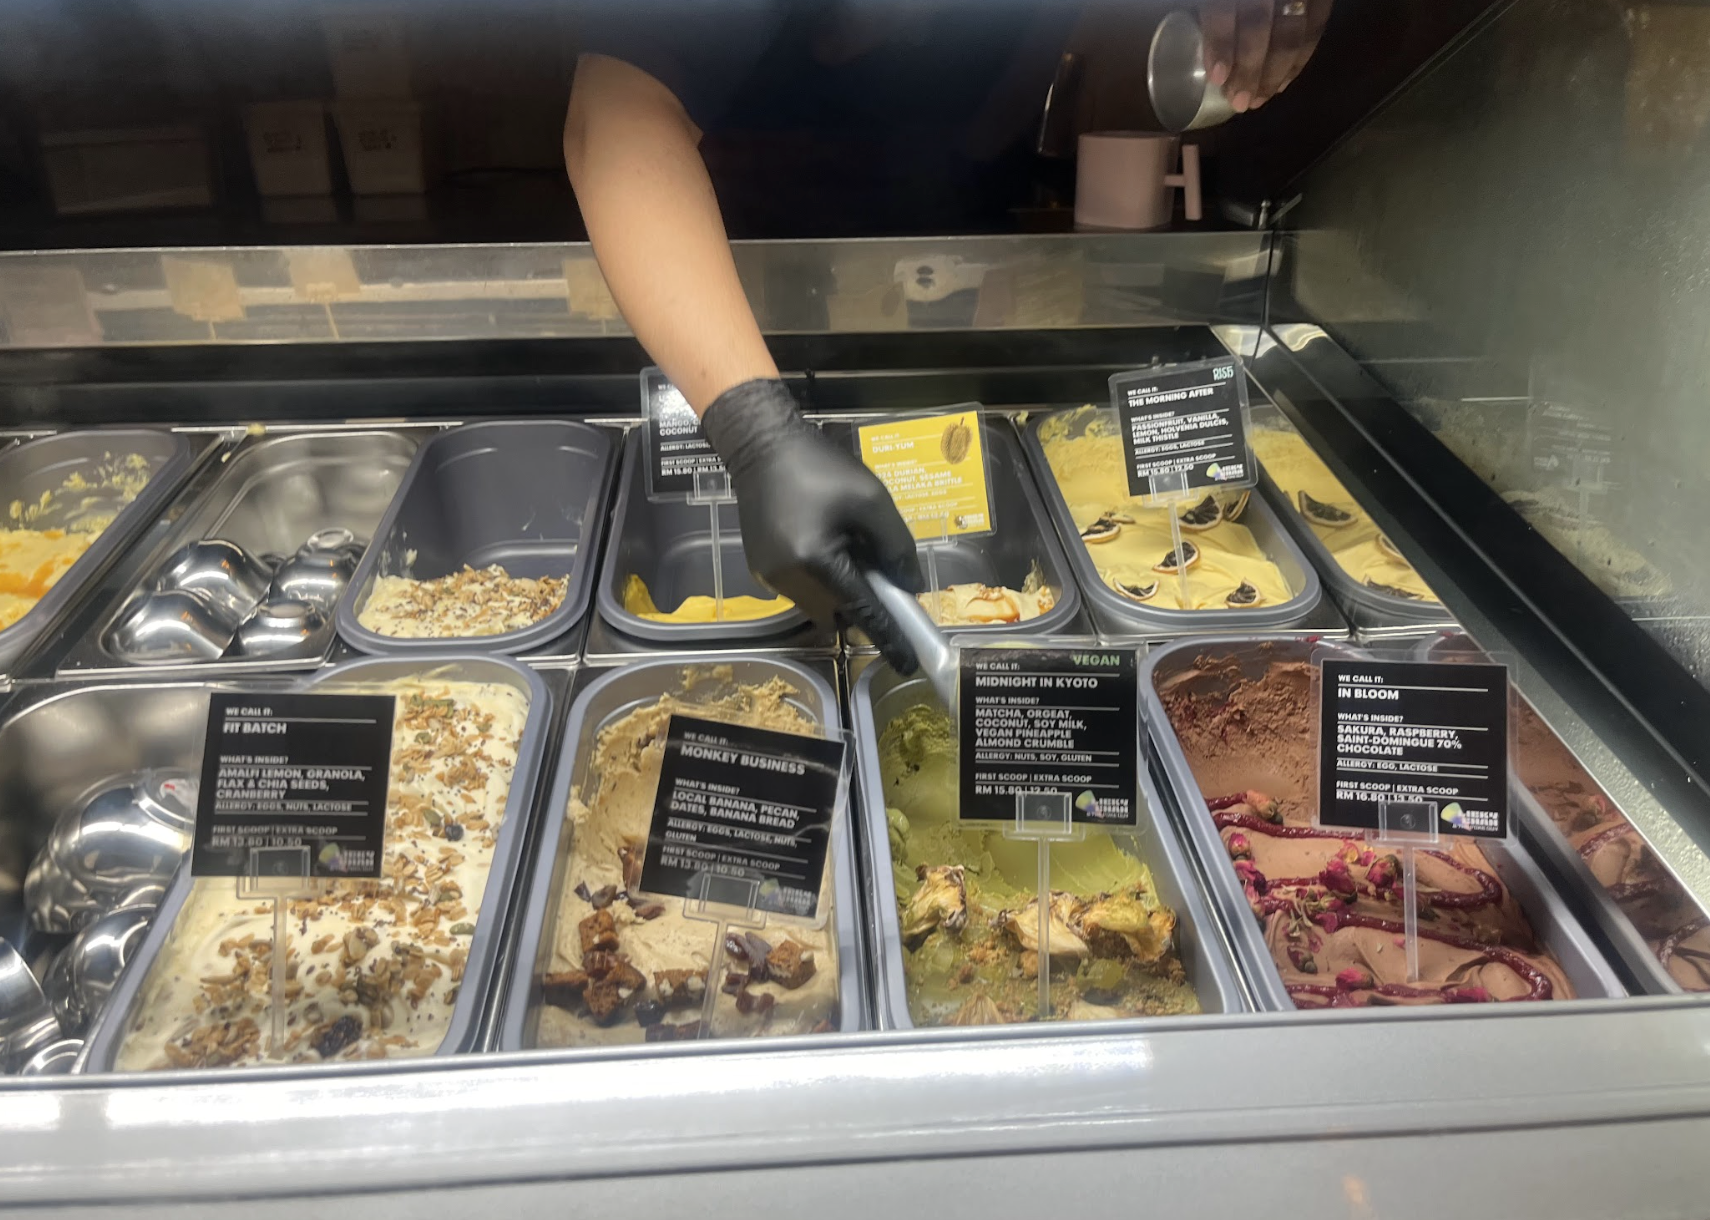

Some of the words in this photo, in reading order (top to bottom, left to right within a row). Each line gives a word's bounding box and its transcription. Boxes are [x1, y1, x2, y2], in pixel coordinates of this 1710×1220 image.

[1129, 398, 1144, 407] THE
[1146, 392, 1187, 405] MORNING
[1189, 388, 1213, 398] AFTER
[660, 426, 698, 436] COCONUT
[1133, 429, 1159, 438] LEMON,
[1152, 433, 1179, 442] THISTLE
[1154, 459, 1172, 468] SCOOP
[1196, 453, 1216, 461] SCOOP
[919, 471, 951, 480] SESAME
[901, 481, 931, 491] MELAKA
[935, 477, 962, 486] BRITTLE
[1073, 655, 1120, 666] VEGAN
[976, 677, 1036, 687] MIDNIGHT
[1040, 678, 1052, 687] IN
[1056, 678, 1098, 688] KYOTO
[1338, 688, 1351, 698] IN
[1354, 689, 1399, 700] BLOOM
[226, 707, 239, 716] WE
[241, 708, 261, 716] CALL
[976, 709, 1024, 719] MATCHA,
[1027, 710, 1072, 720] ORGEAT,
[1338, 713, 1369, 721] WHAT'S
[1371, 714, 1403, 722] INSIDE?
[224, 722, 240, 733] FIT
[243, 723, 287, 734] BATCH
[976, 719, 1031, 729] COCONUT,
[1034, 720, 1055, 728] SOY
[1059, 720, 1087, 730] MILK,
[684, 731, 696, 740] WE
[698, 733, 714, 743] CALL
[976, 729, 1013, 737] VEGAN
[1015, 729, 1071, 738] PINEAPPLE
[1338, 725, 1386, 738] SAKURA,
[1389, 728, 1458, 740] RASPBERRY,
[975, 739, 1021, 748] ALMOND
[1024, 740, 1074, 748] CRUMBLE
[1337, 735, 1434, 748] SAINT-DOMINGUE
[1437, 740, 1462, 749] 70%
[1337, 745, 1403, 755] CHOCOLATE
[254, 756, 288, 764] INSIDE?
[681, 745, 737, 764] MONKEY
[740, 754, 805, 775] BUSINESS
[1040, 754, 1058, 762] SOY,
[1337, 760, 1375, 769] ALLERGY:
[1377, 762, 1397, 771] EGG,
[1400, 763, 1438, 772] LACTOSE
[219, 769, 260, 778] AMALFI
[262, 770, 303, 779] LEMON,
[307, 770, 365, 781] GRANOLA,
[218, 780, 244, 788] FLAX
[258, 780, 288, 789] CHIA
[291, 780, 329, 791] SEEDS,
[675, 778, 706, 790] WHAT'S
[708, 783, 740, 795] INSIDE?
[975, 786, 992, 794] RM
[1336, 781, 1358, 789] FIRST
[1360, 783, 1390, 792] SCOOP
[1397, 785, 1424, 793] EXTRA
[1427, 787, 1458, 795] SCOOP
[216, 790, 286, 799] CRANBERRY
[1336, 792, 1353, 800] RM
[1355, 793, 1385, 802] 16.80
[673, 790, 706, 806] LOCAL
[709, 797, 758, 814] BANANA,
[761, 805, 799, 820] PECAN,
[671, 801, 707, 816] DATES,
[710, 807, 756, 823] BANANA
[759, 815, 795, 829] BREAD
[666, 831, 696, 842] GLUTEN
[661, 856, 678, 867] RM
[722, 855, 748, 866] EXTRA
[750, 859, 780, 871] SCOOP
